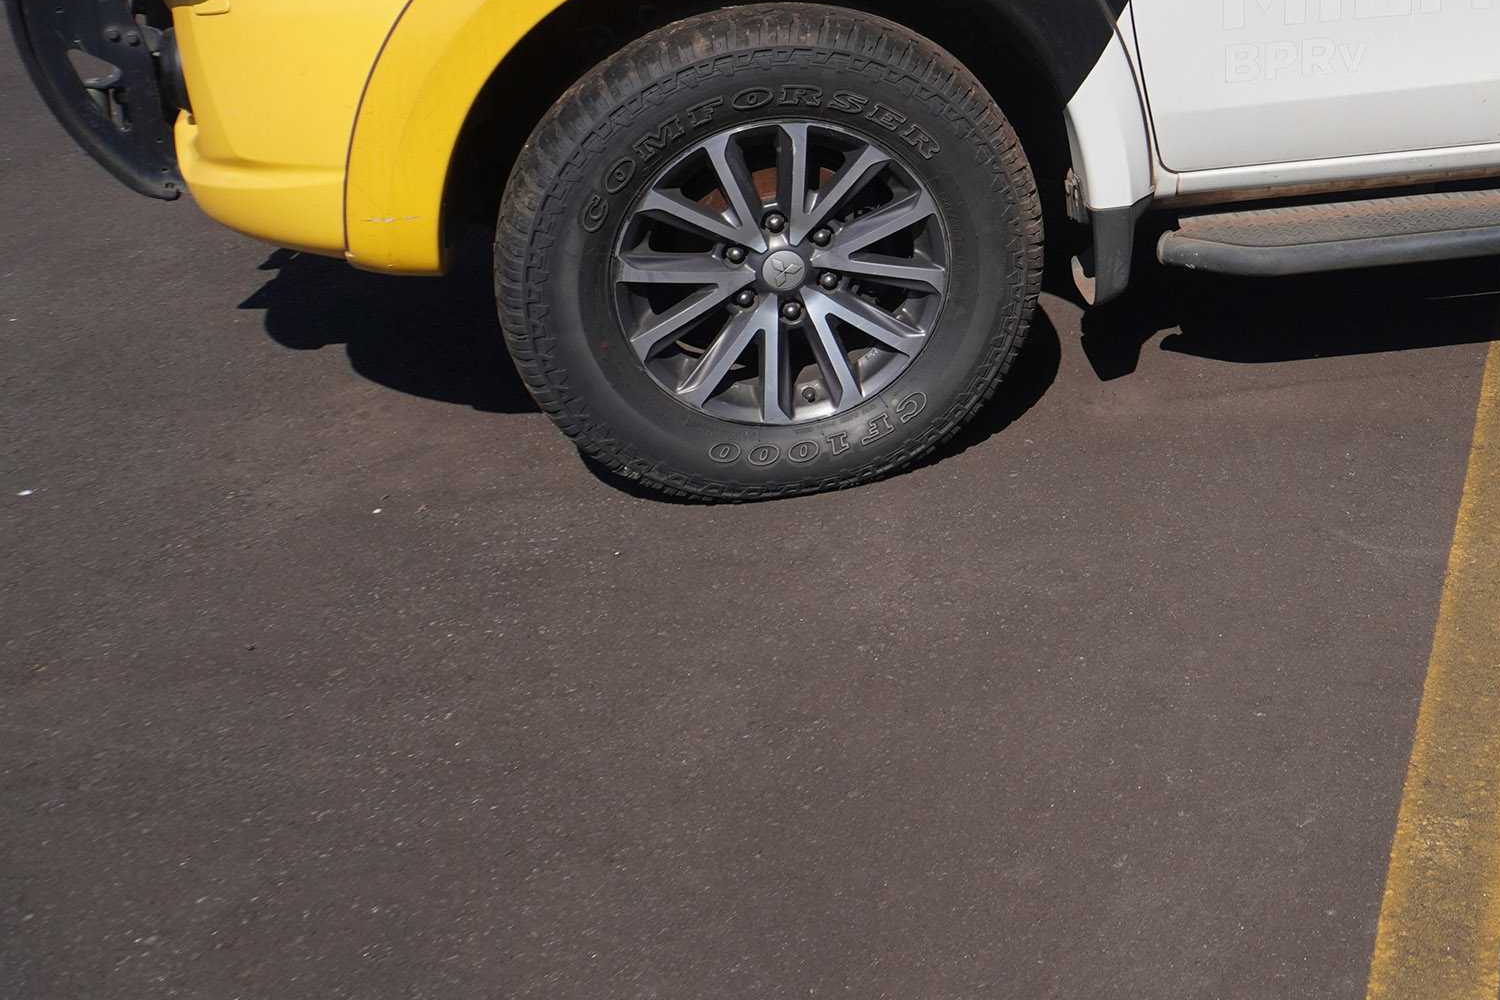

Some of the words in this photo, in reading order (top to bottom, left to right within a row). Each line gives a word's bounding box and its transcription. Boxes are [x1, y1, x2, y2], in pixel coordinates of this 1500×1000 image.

[1224, 37, 1369, 84] BPRv
[577, 83, 946, 235] COMFORSER
[708, 388, 928, 466] CF1000
